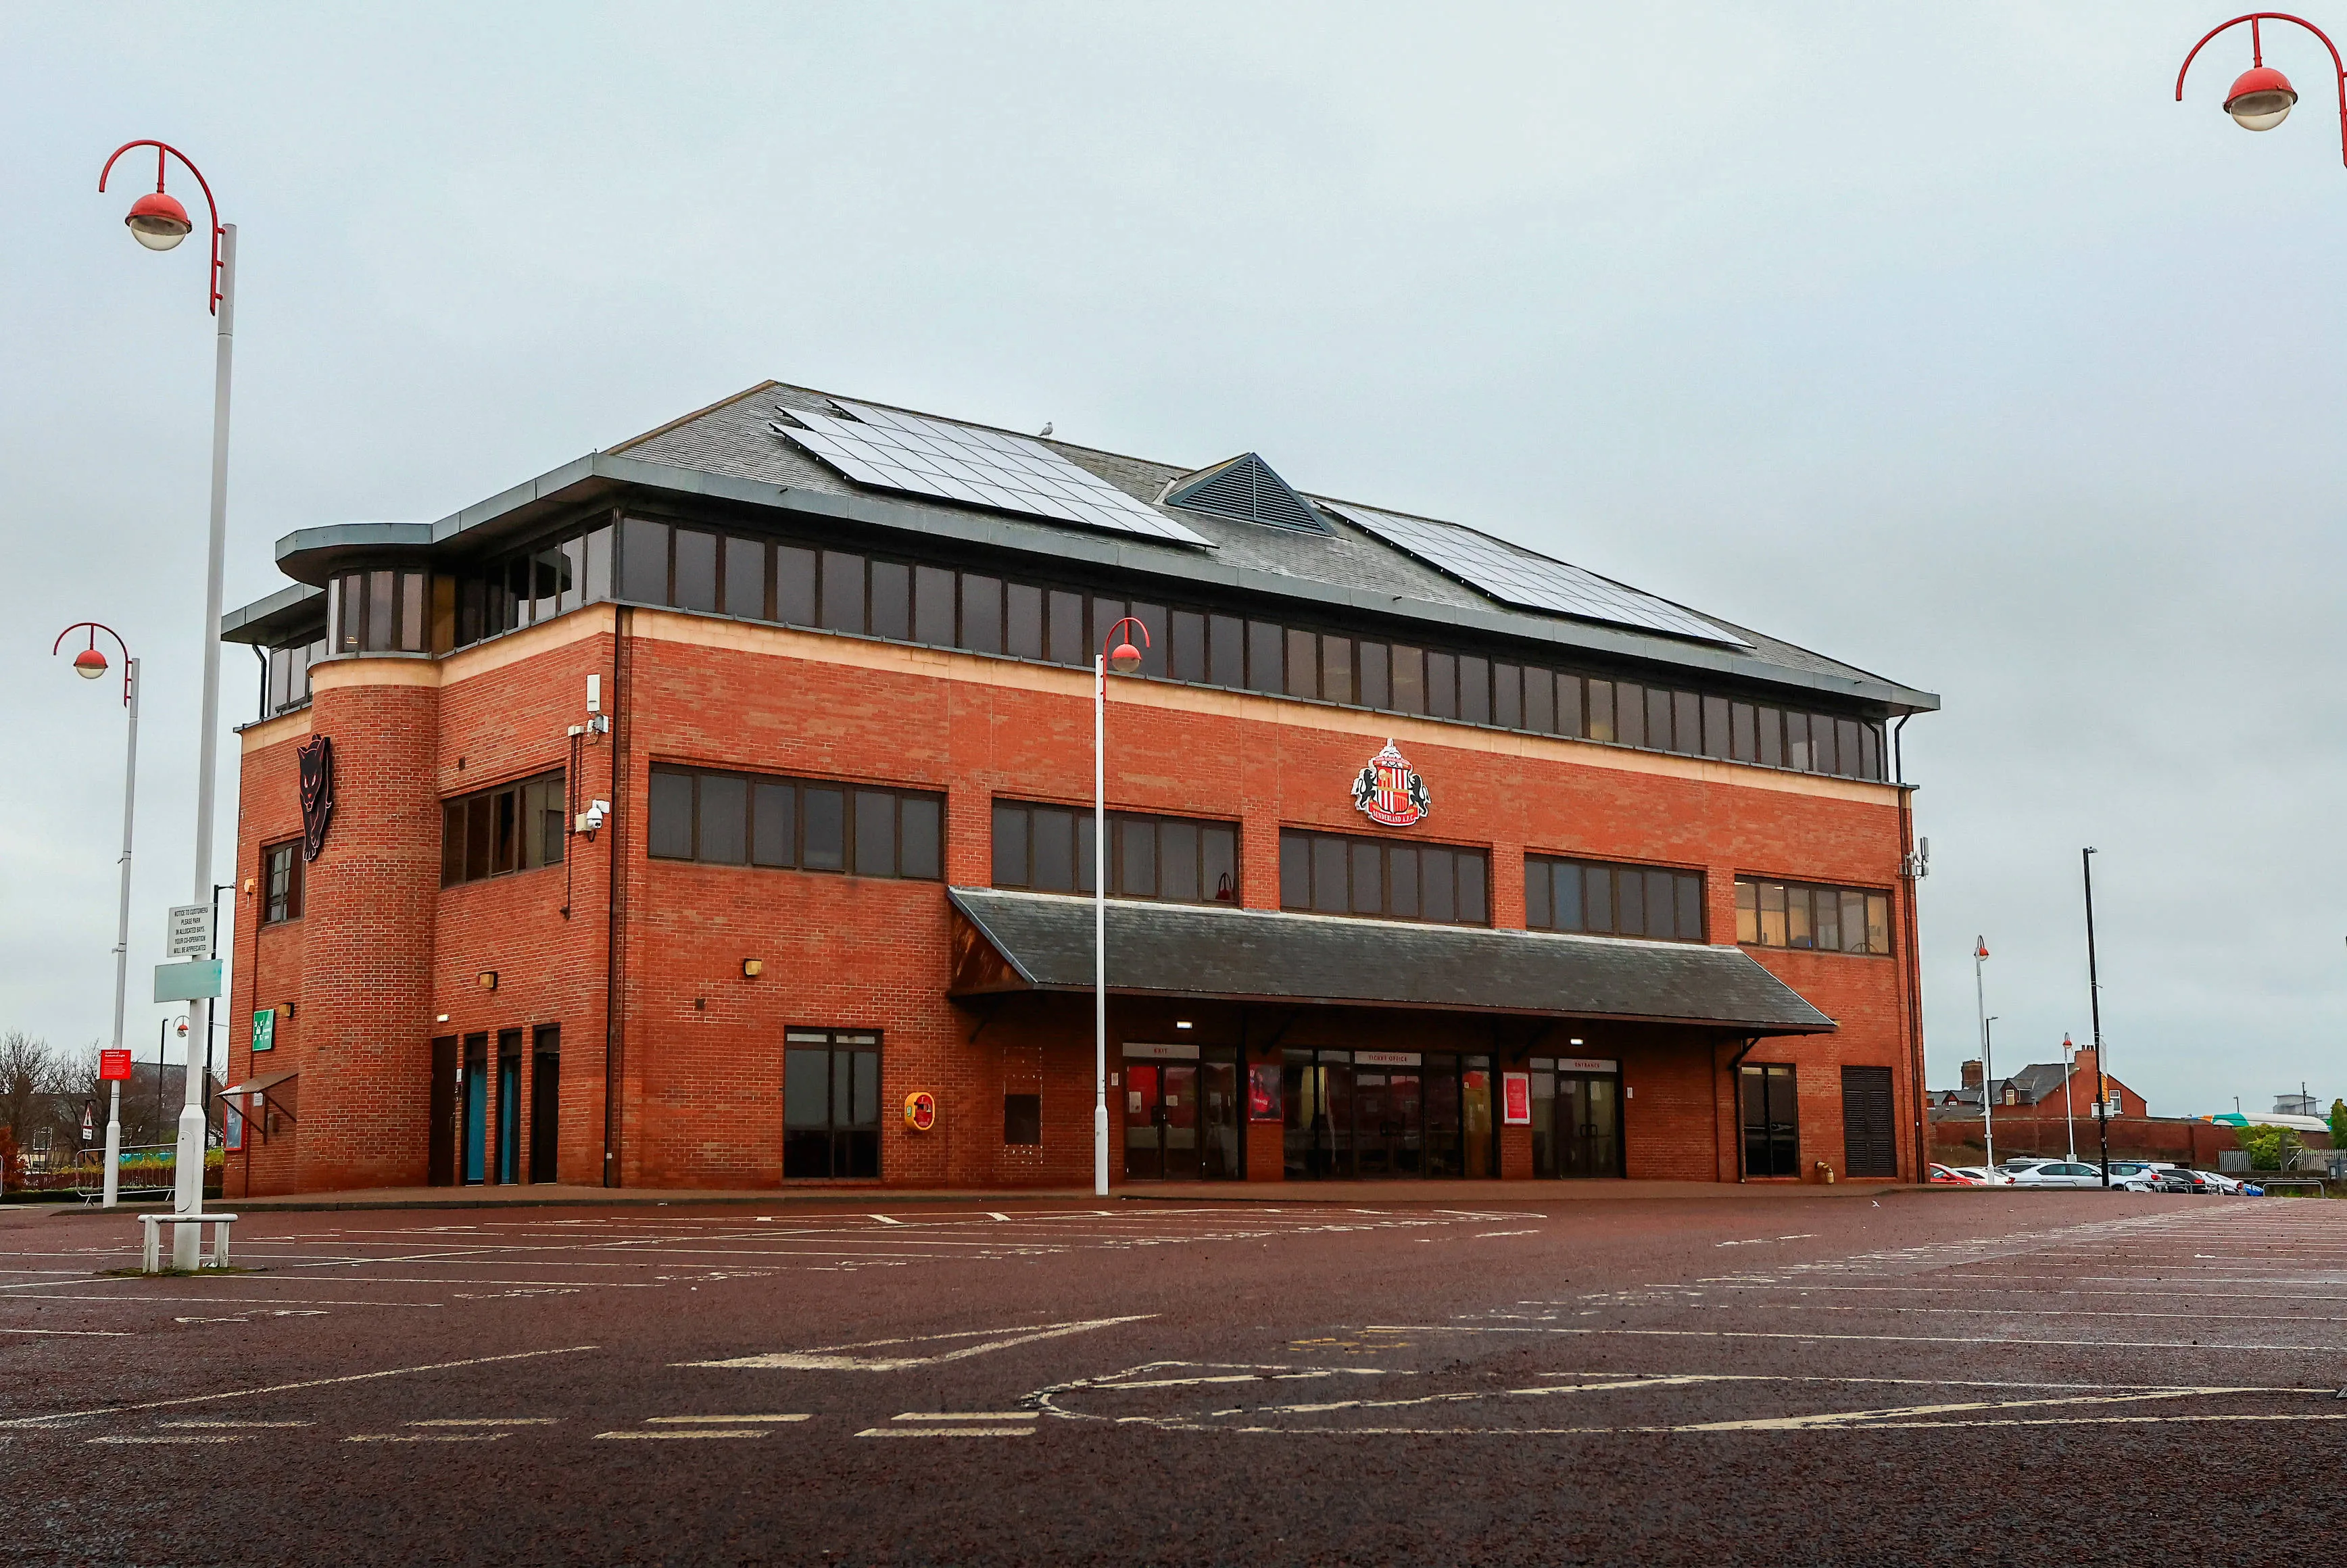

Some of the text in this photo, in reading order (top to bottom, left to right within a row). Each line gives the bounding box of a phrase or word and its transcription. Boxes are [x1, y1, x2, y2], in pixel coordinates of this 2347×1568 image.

[1373, 810, 1401, 822] SUNDERLAND
[190, 907, 208, 915] CUSTOMERS
[184, 935, 205, 944] CO-OPERATION
[186, 944, 206, 952] APPRECIATED
